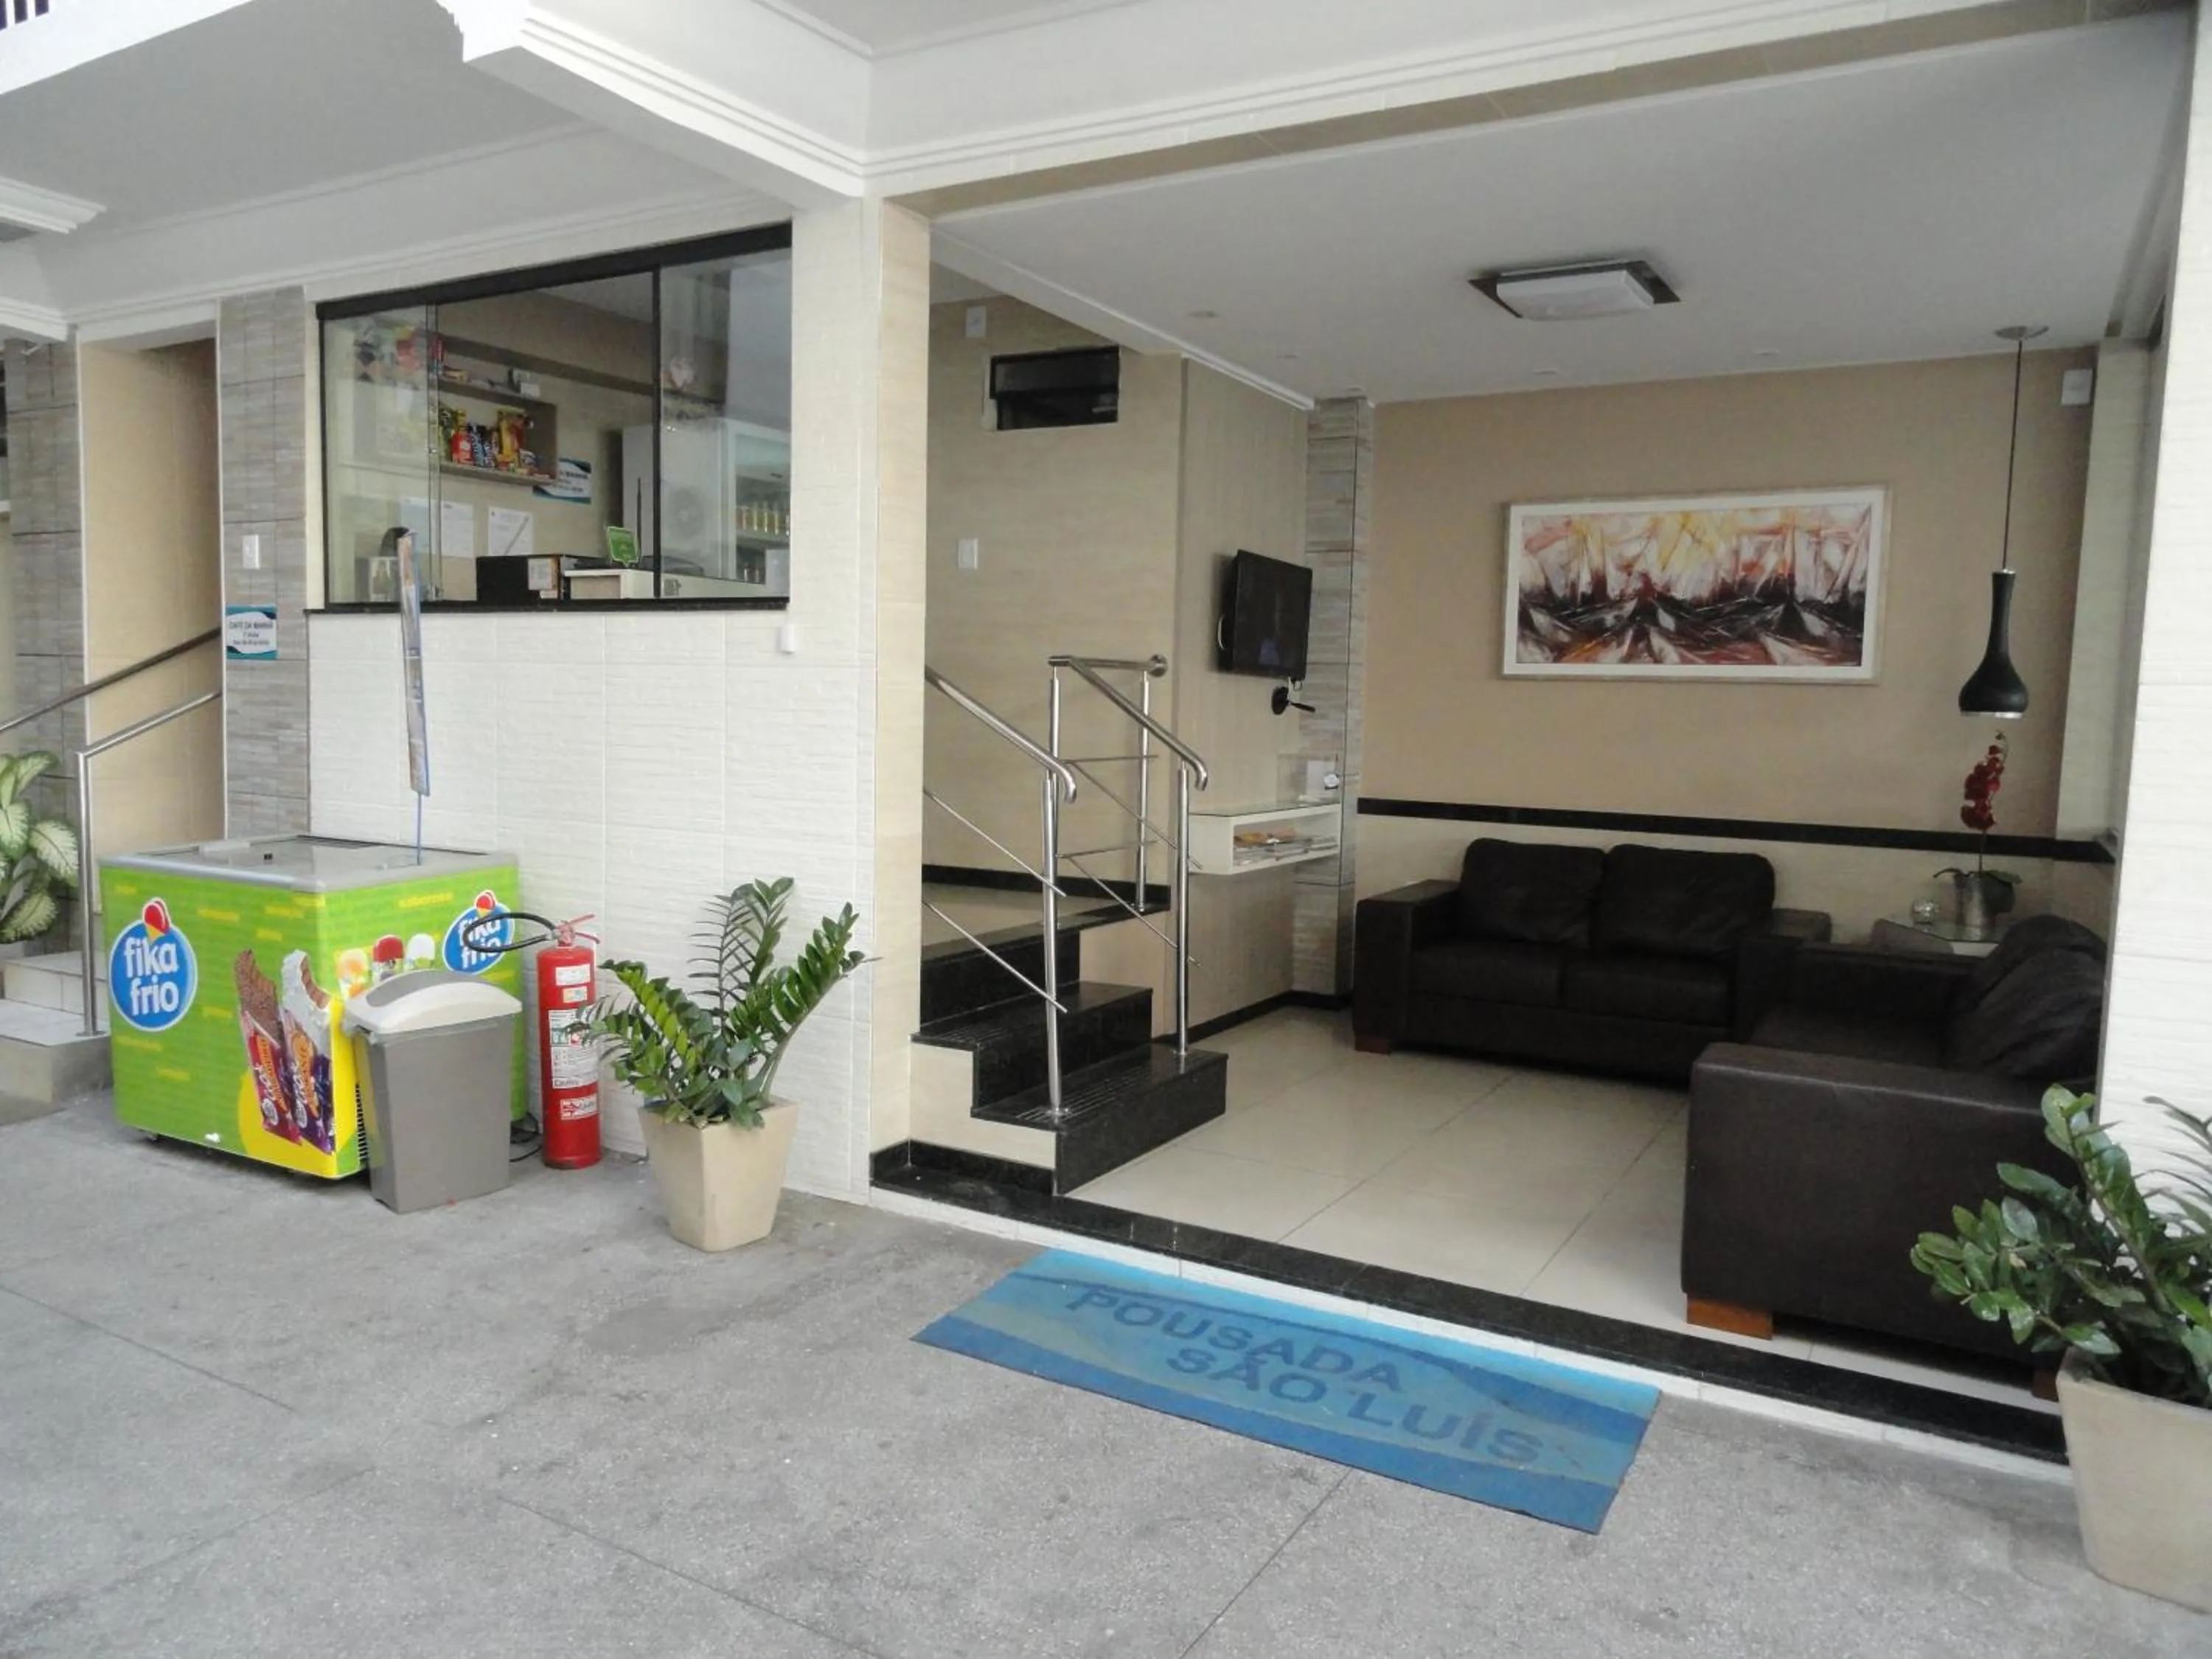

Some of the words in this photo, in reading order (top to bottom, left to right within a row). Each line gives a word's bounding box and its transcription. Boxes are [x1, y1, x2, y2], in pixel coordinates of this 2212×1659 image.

[124, 936, 179, 978] fika
[131, 974, 179, 1015] frio
[1064, 1285, 1399, 1391] POUSADA
